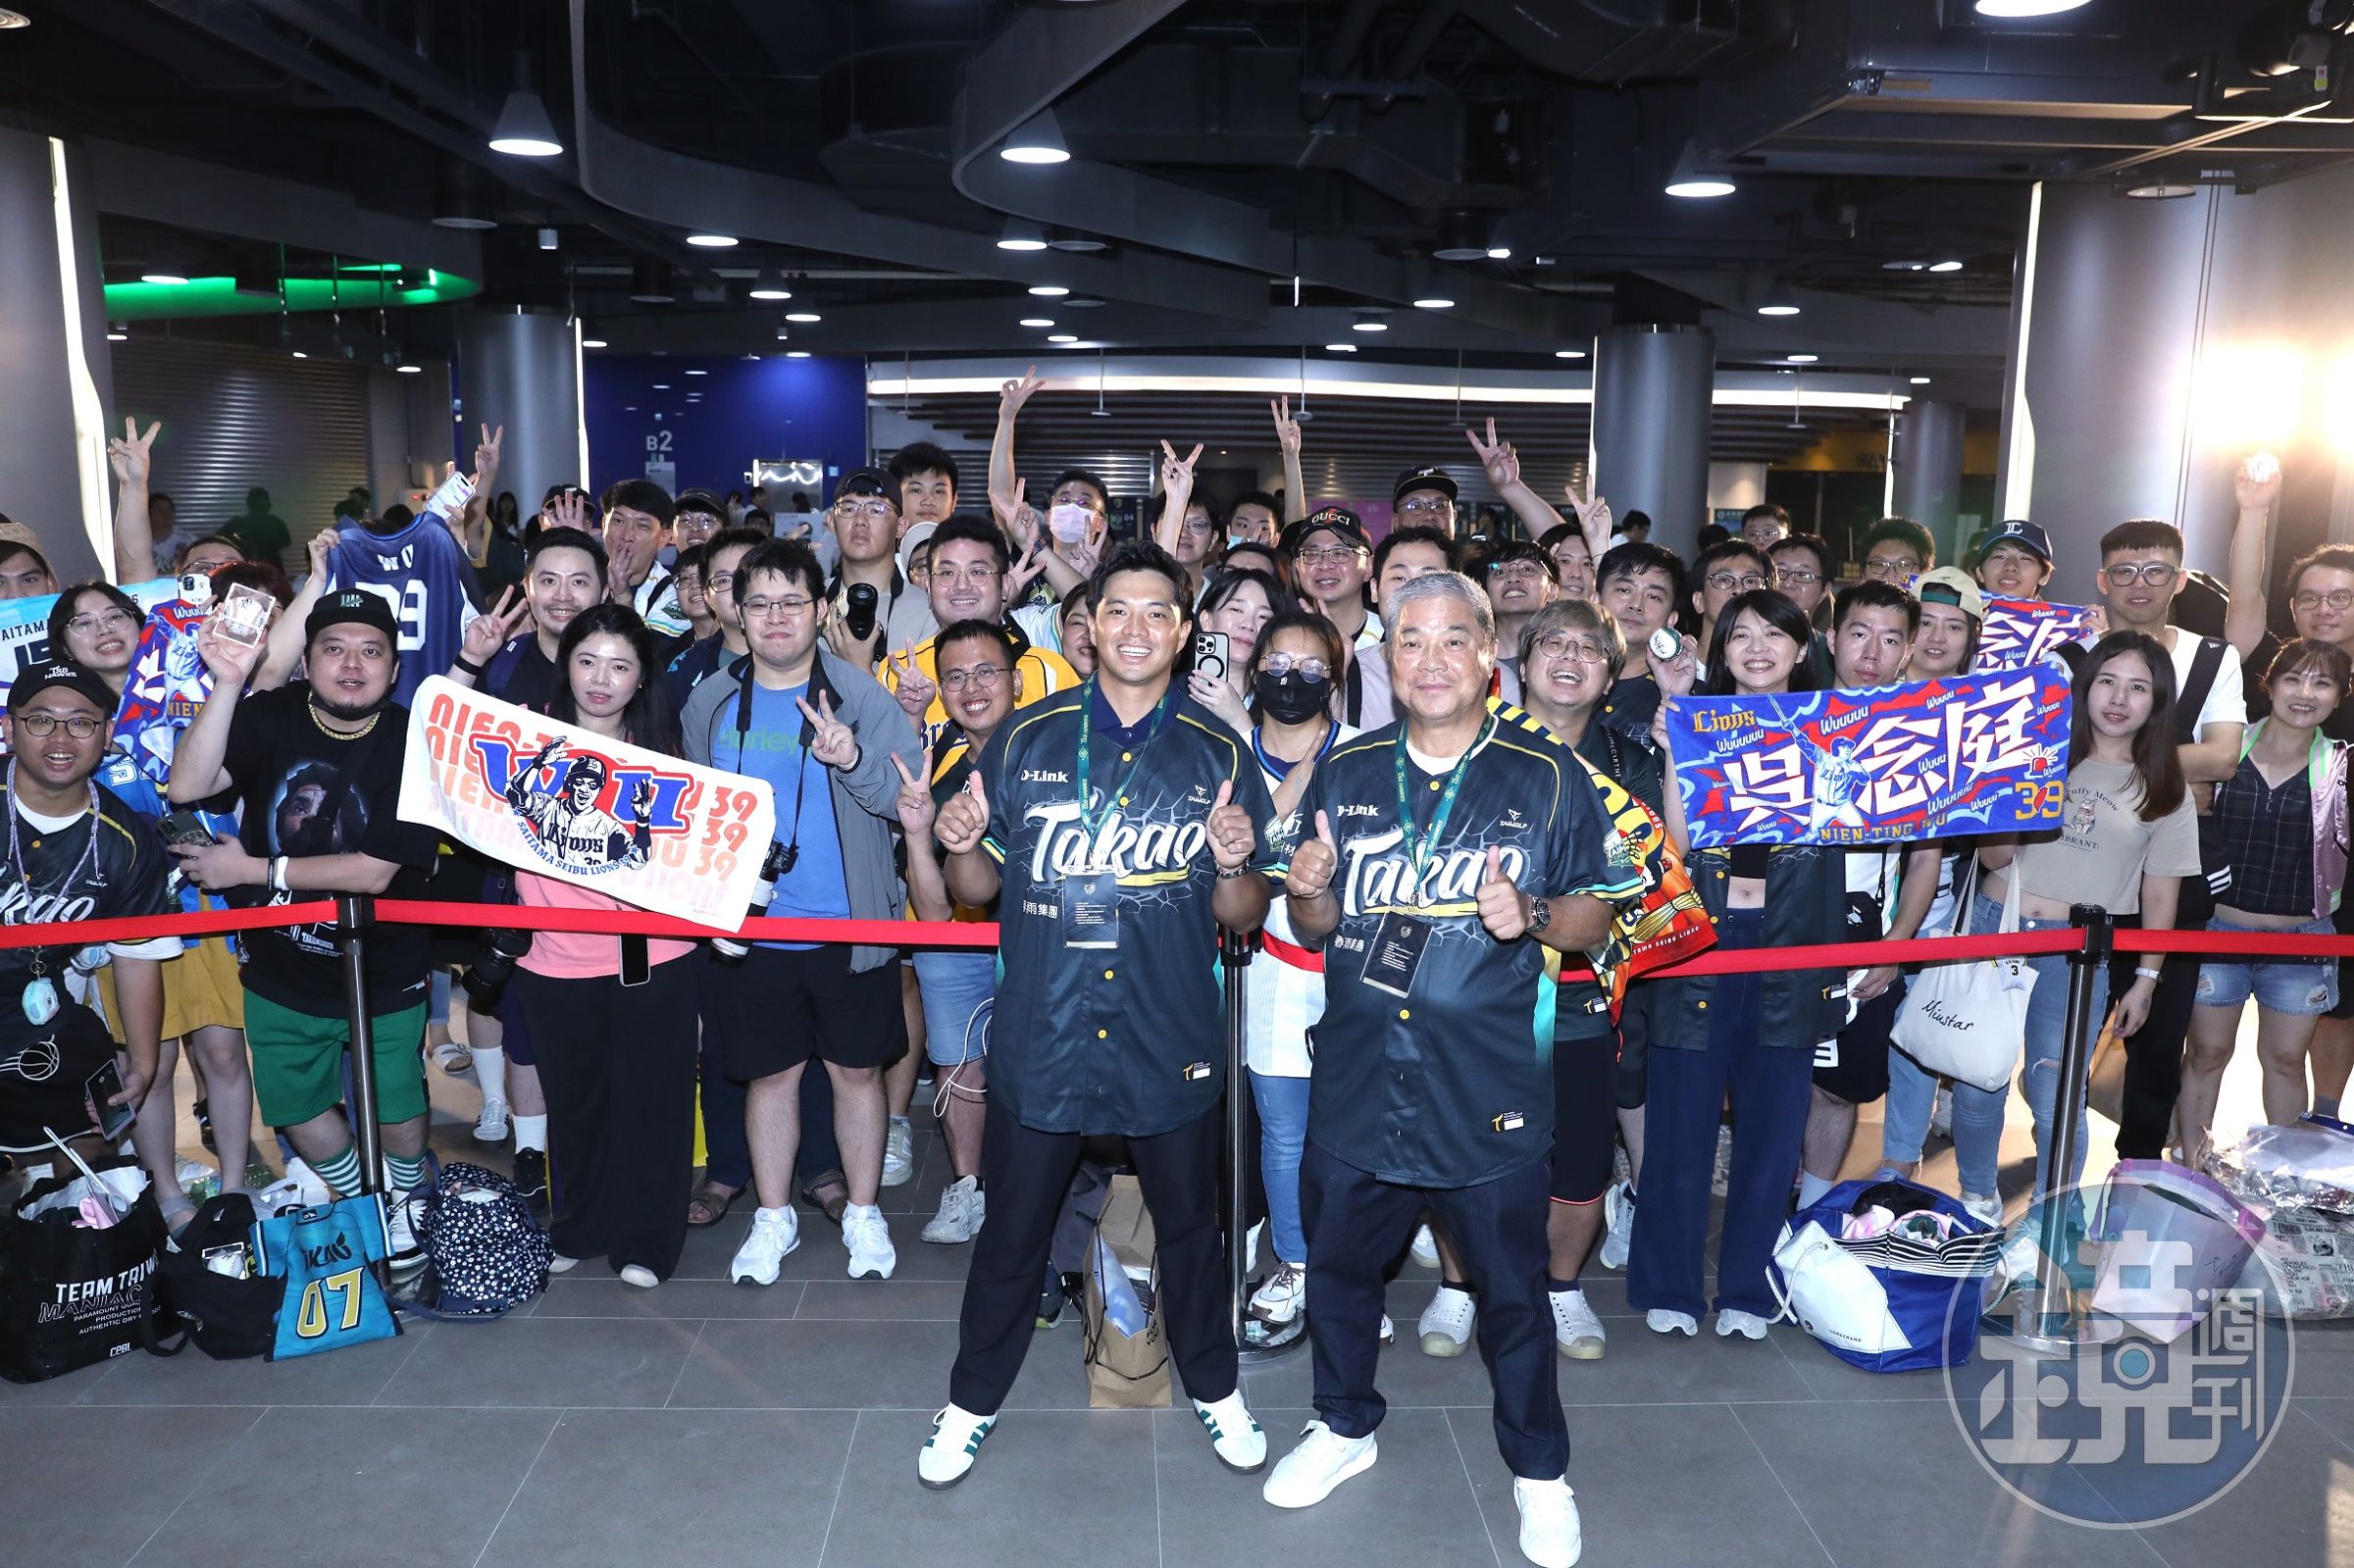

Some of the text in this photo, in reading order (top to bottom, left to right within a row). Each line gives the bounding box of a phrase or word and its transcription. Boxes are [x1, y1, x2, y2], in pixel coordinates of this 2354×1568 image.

[646, 430, 673, 451] B2
[1311, 510, 1350, 526] GUCCI
[0, 617, 49, 640] AITAM
[1694, 710, 1757, 733] Lions
[2015, 781, 2065, 820] 39
[1025, 786, 1206, 885] Takao
[2061, 835, 2099, 850] IBRANT
[517, 821, 554, 865] SAITAMA
[555, 859, 588, 876] SEIBU
[590, 859, 620, 875] LIONS
[1346, 829, 1522, 917] Takao
[1632, 942, 1654, 956] TAMA
[2011, 964, 2019, 976] 3
[55, 1252, 159, 1304] TEAM TAIW
[37, 1284, 143, 1324] MANIAC
[74, 1305, 120, 1323] PARAMOUNT
[296, 1267, 366, 1340] 07
[78, 1315, 138, 1336] AUTHENTIC DRY
[95, 1306, 141, 1324] PRODUCTIO
[109, 1341, 132, 1358] CPBL
